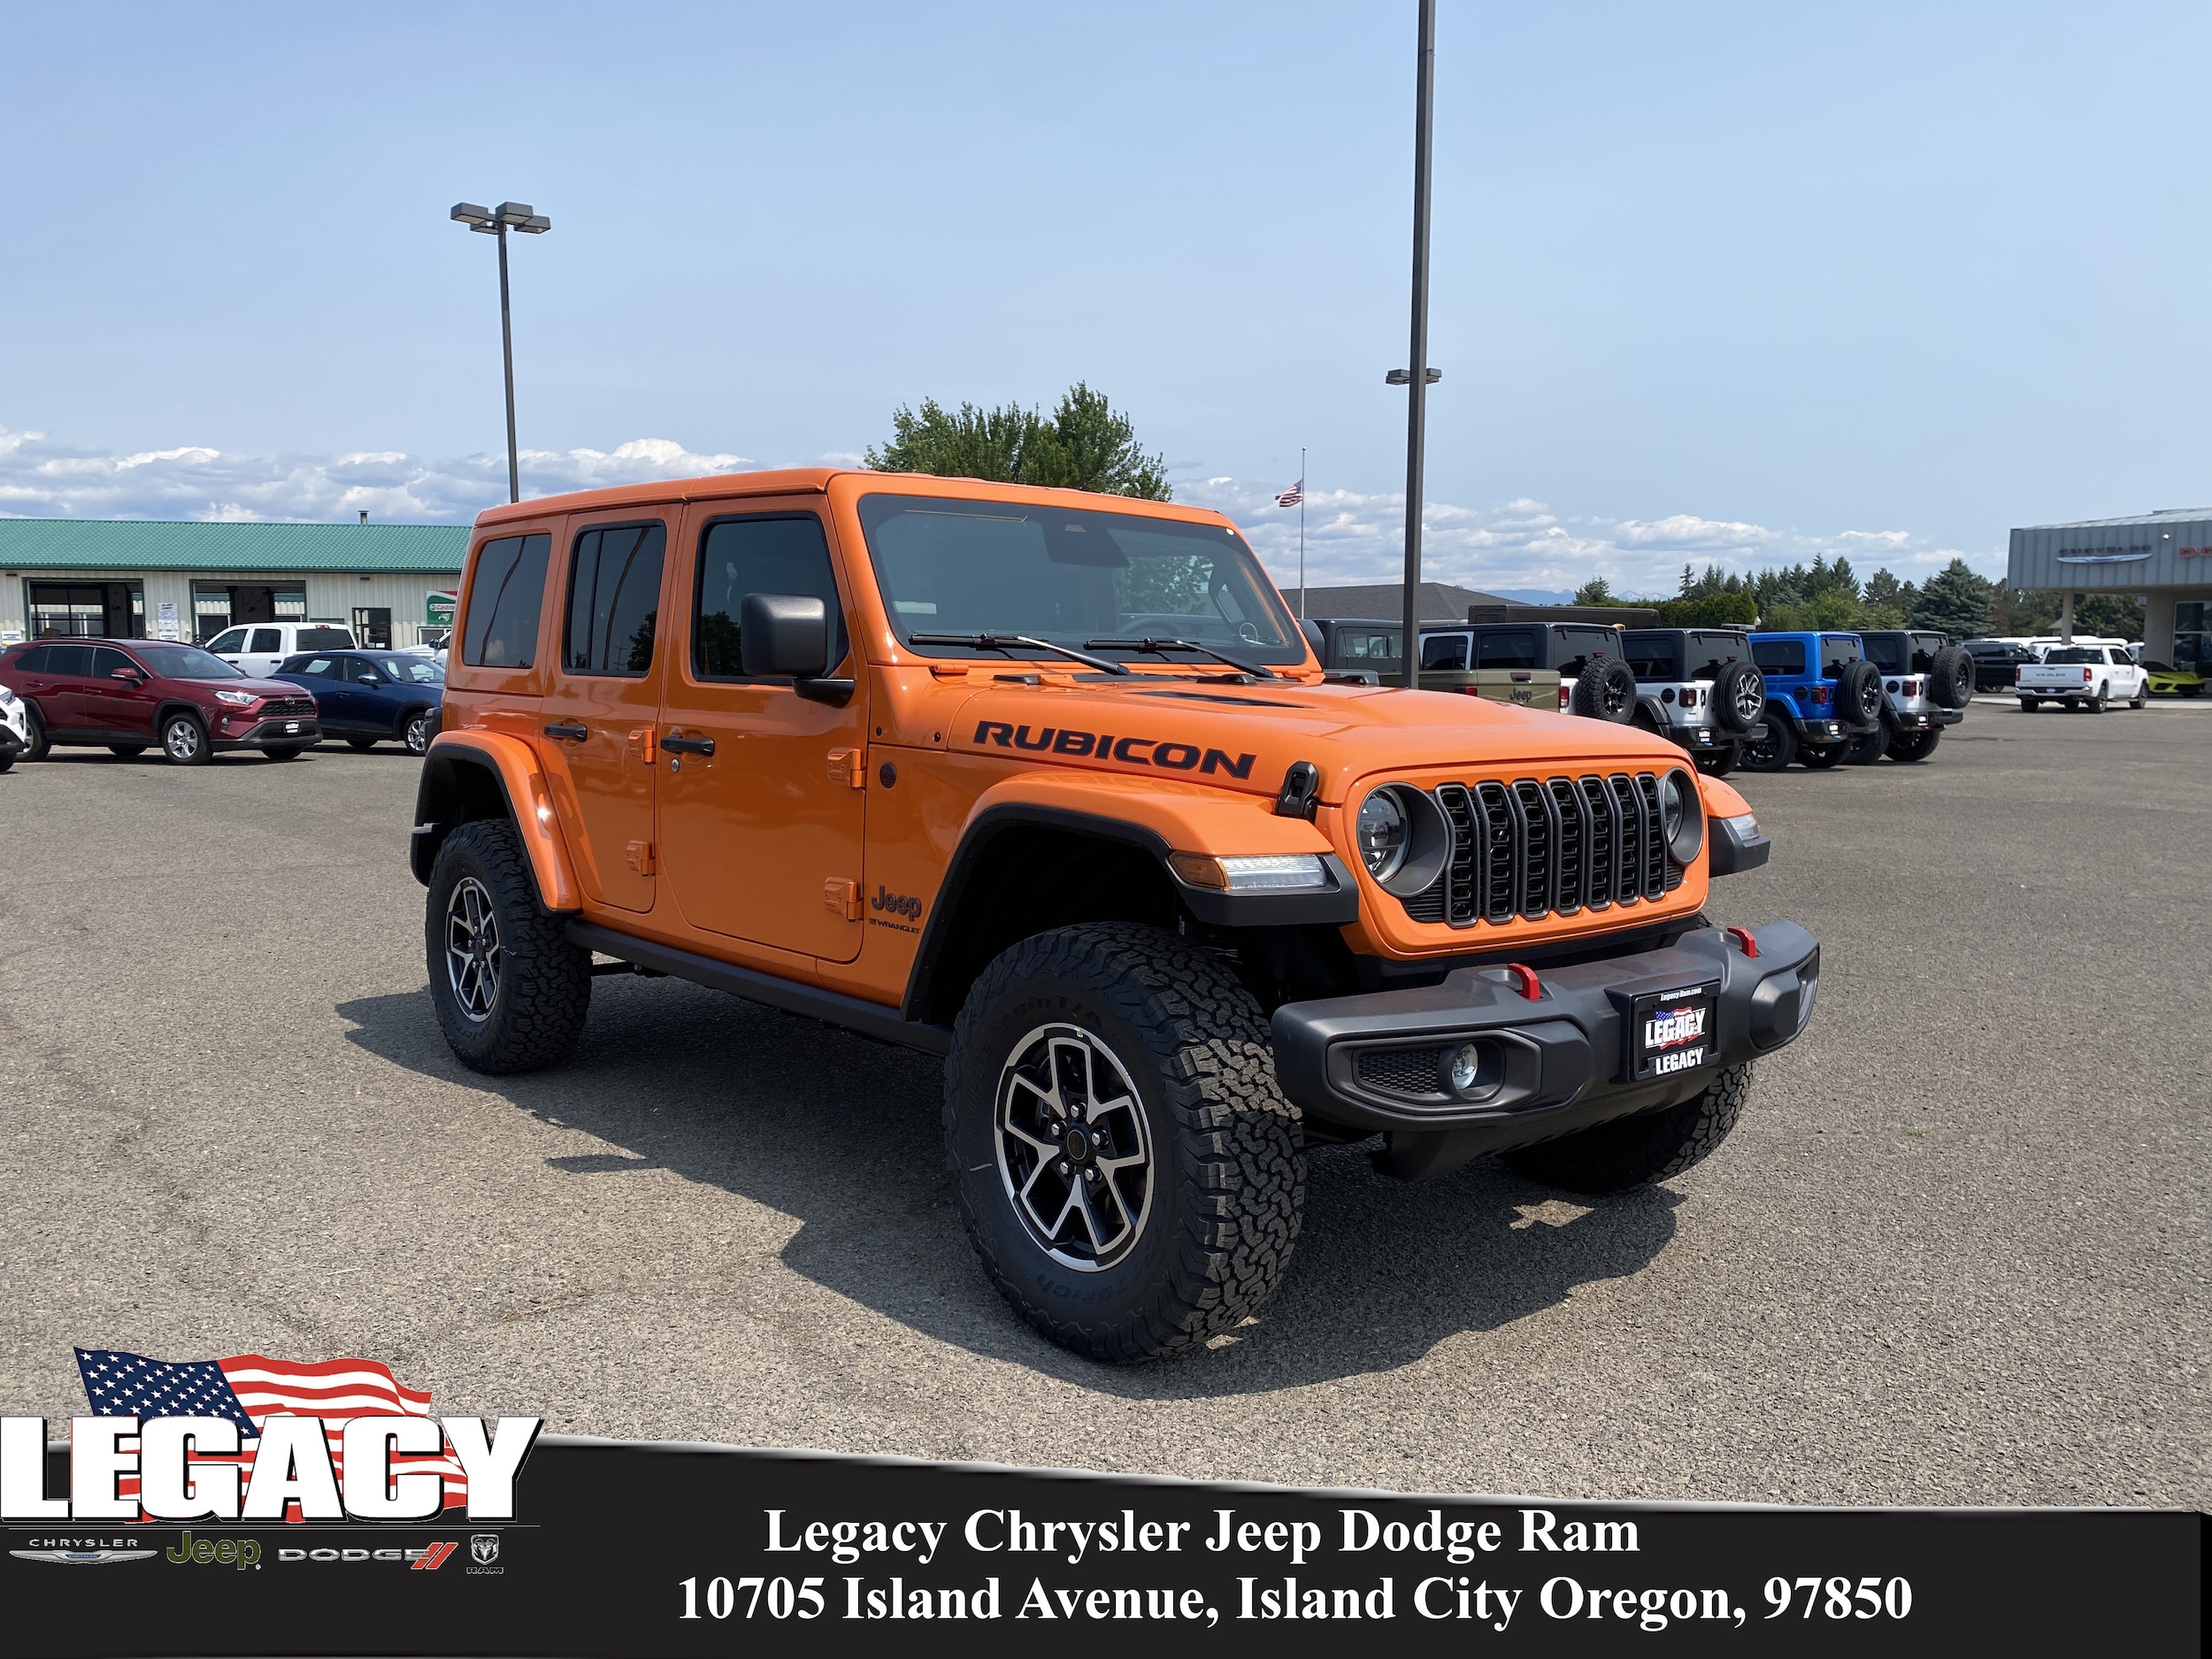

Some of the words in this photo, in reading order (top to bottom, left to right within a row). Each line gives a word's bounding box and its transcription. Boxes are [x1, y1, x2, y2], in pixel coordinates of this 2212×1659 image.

[1509, 687, 1532, 703] Jeep
[973, 720, 1257, 780] RUBICON
[872, 885, 922, 922] Jeep
[1646, 1010, 1706, 1046] LEGACY
[1655, 1048, 1704, 1075] LEGACY
